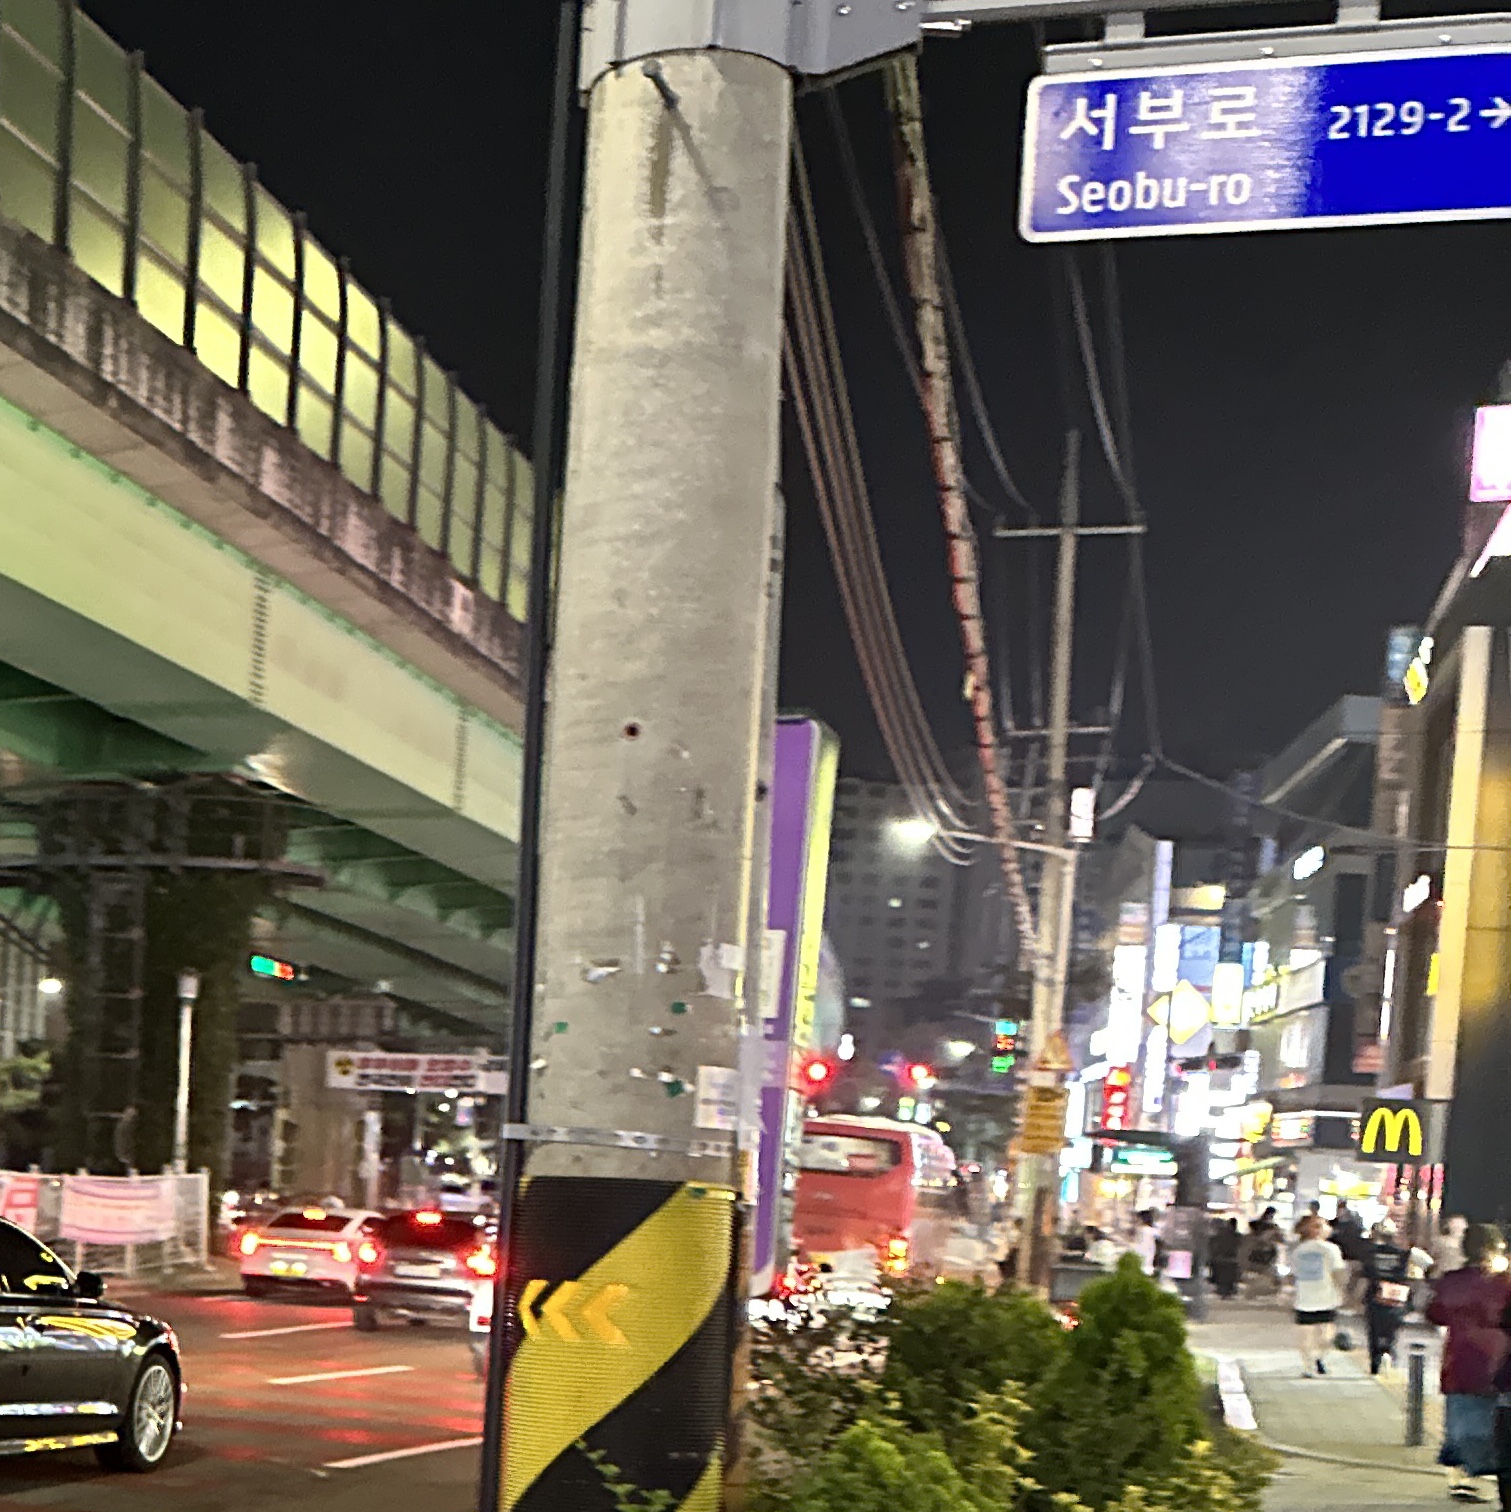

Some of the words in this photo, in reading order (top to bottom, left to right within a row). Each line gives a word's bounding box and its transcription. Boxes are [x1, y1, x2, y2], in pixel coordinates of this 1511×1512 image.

[1059, 86, 1262, 151] 서부로
[1327, 97, 1472, 141] 2129-2
[1055, 172, 1252, 216] Seobu-ro
